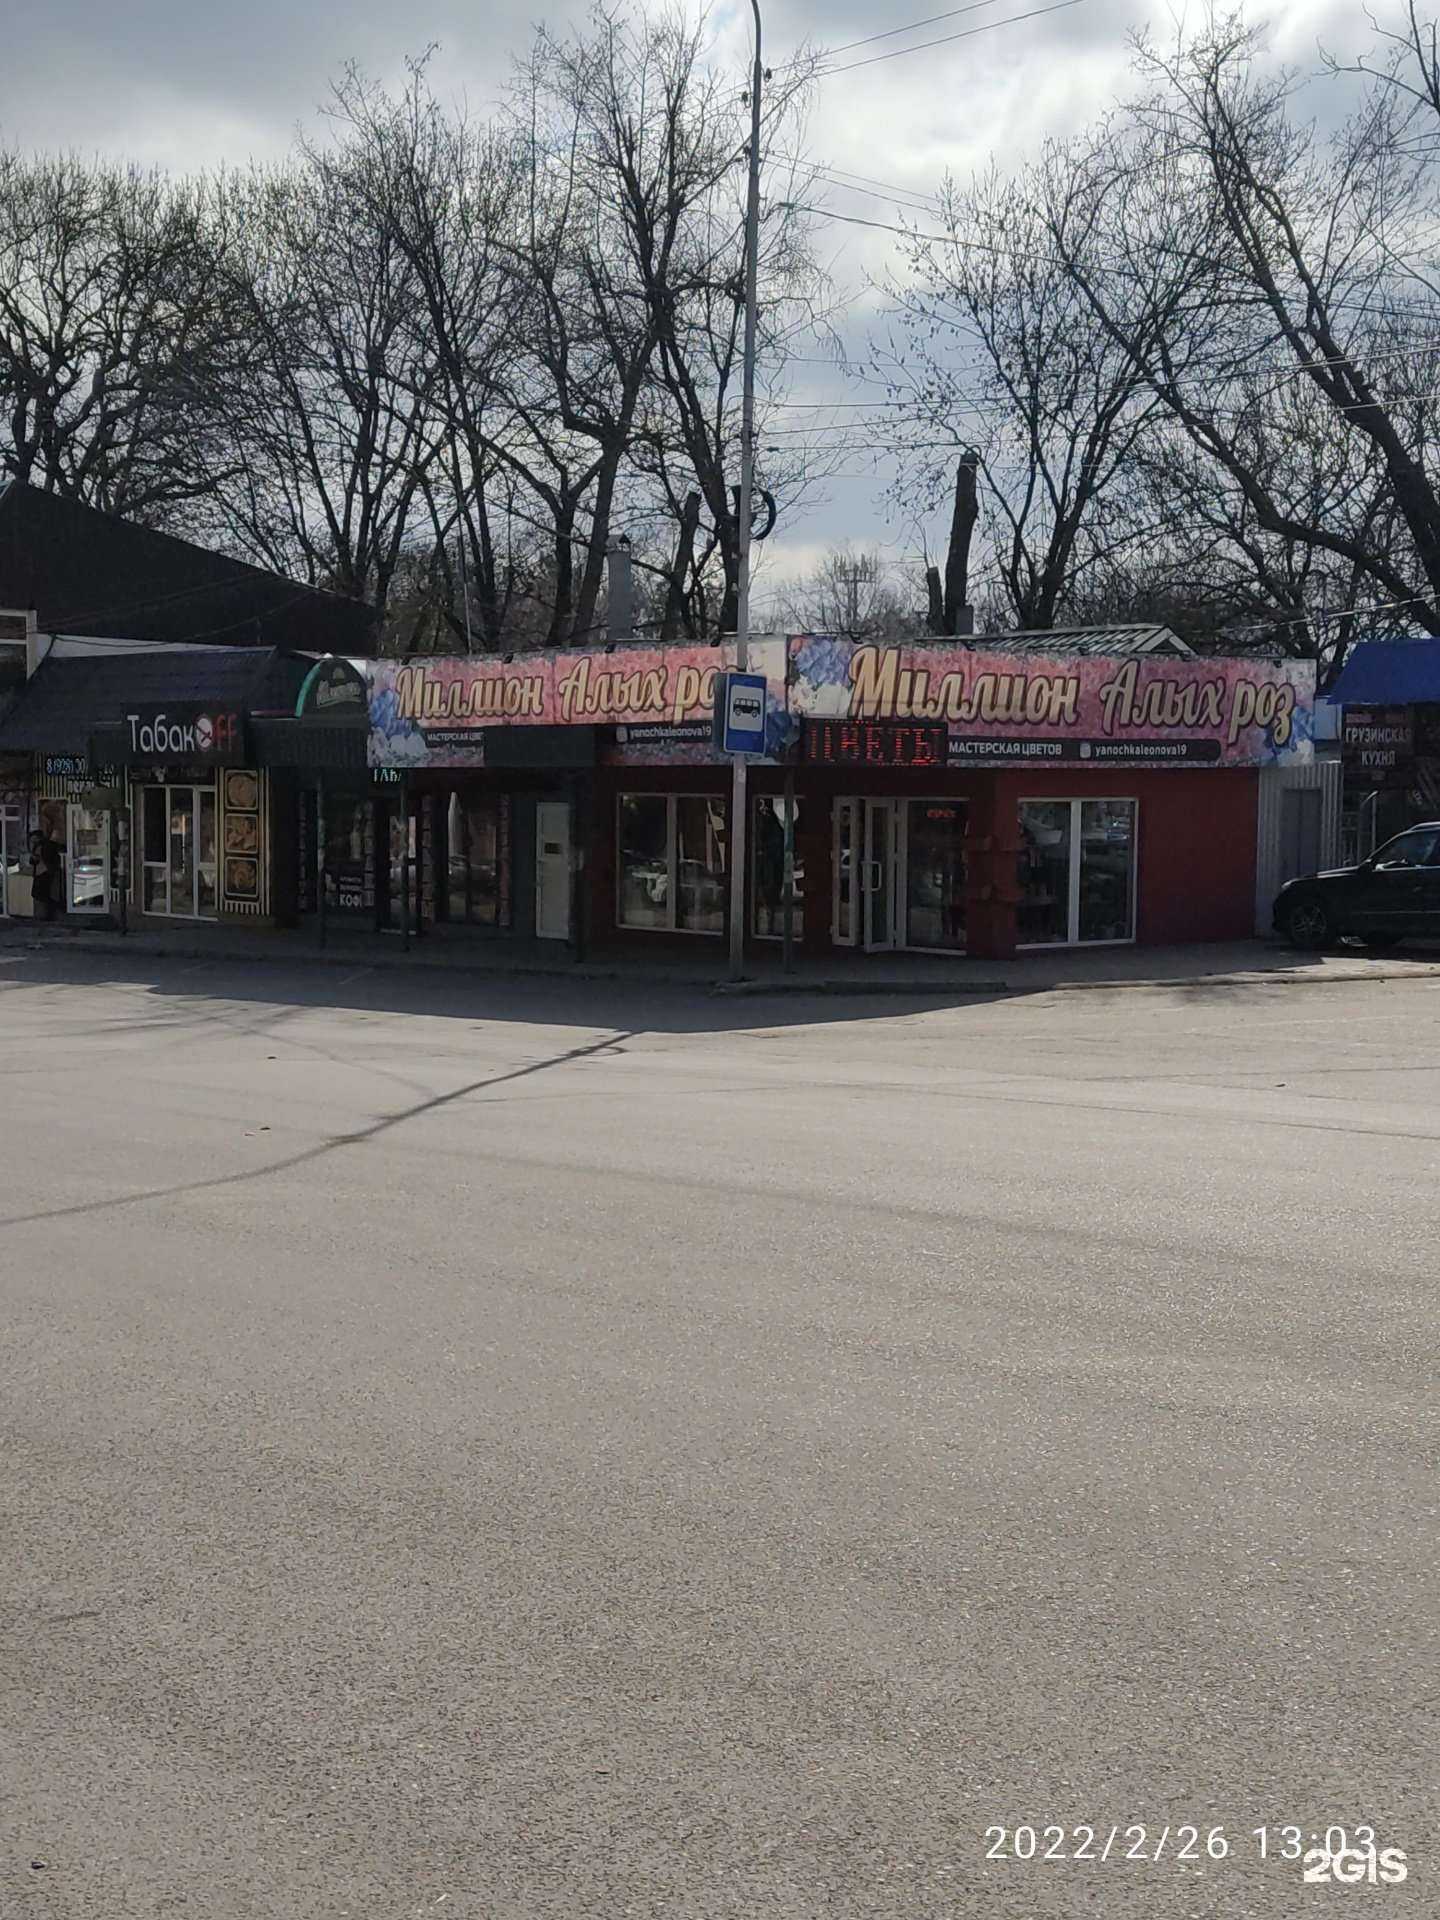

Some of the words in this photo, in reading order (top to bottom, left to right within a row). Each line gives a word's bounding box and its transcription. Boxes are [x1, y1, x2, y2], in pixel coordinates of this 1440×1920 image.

[396, 668, 542, 719] Миллион
[555, 656, 668, 721] Алых
[673, 665, 738, 725] ро
[848, 645, 1079, 725] Миллион
[1100, 658, 1226, 735] Алых
[1227, 678, 1296, 746] роз
[630, 726, 711, 740] yanochkaleonova19
[1345, 727, 1412, 744] ГРУЗИНСКАЯ
[949, 741, 1020, 755] МАСТЕРСКАЯ
[1022, 742, 1062, 757] ЦВЕТОВ
[1094, 743, 1188, 757] yanochkaleonova19
[1361, 750, 1396, 767] КУХНЯ
